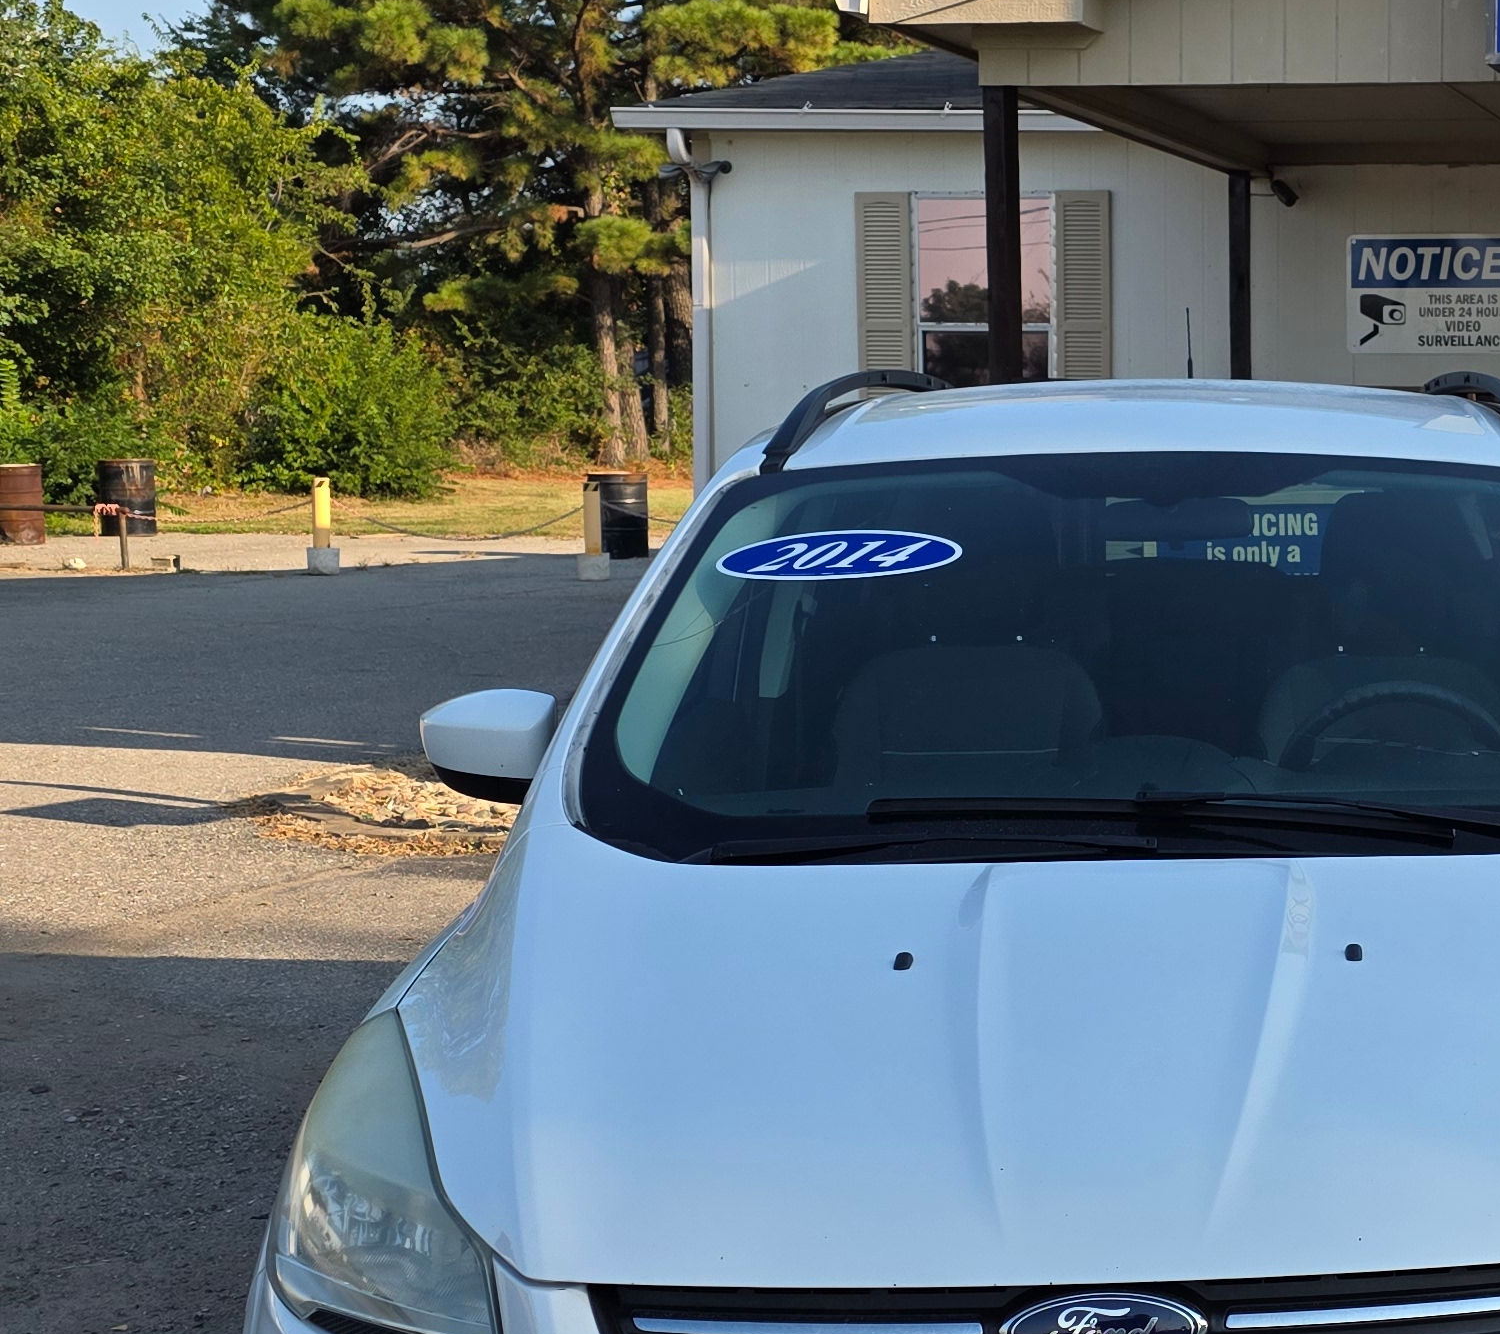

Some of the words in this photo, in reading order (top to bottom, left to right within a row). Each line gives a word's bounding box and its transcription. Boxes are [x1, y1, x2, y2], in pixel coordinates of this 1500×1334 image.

[1428, 294, 1453, 305] THIS
[1455, 294, 1484, 305] AREA
[1487, 294, 1498, 304] IS
[1418, 307, 1455, 318] UNDER
[1458, 307, 1472, 318] 24
[1445, 320, 1481, 332] VIDEO
[746, 539, 932, 573] 2014
[1206, 541, 1226, 561] is
[1232, 541, 1281, 567] only
[1287, 545, 1301, 563] a
